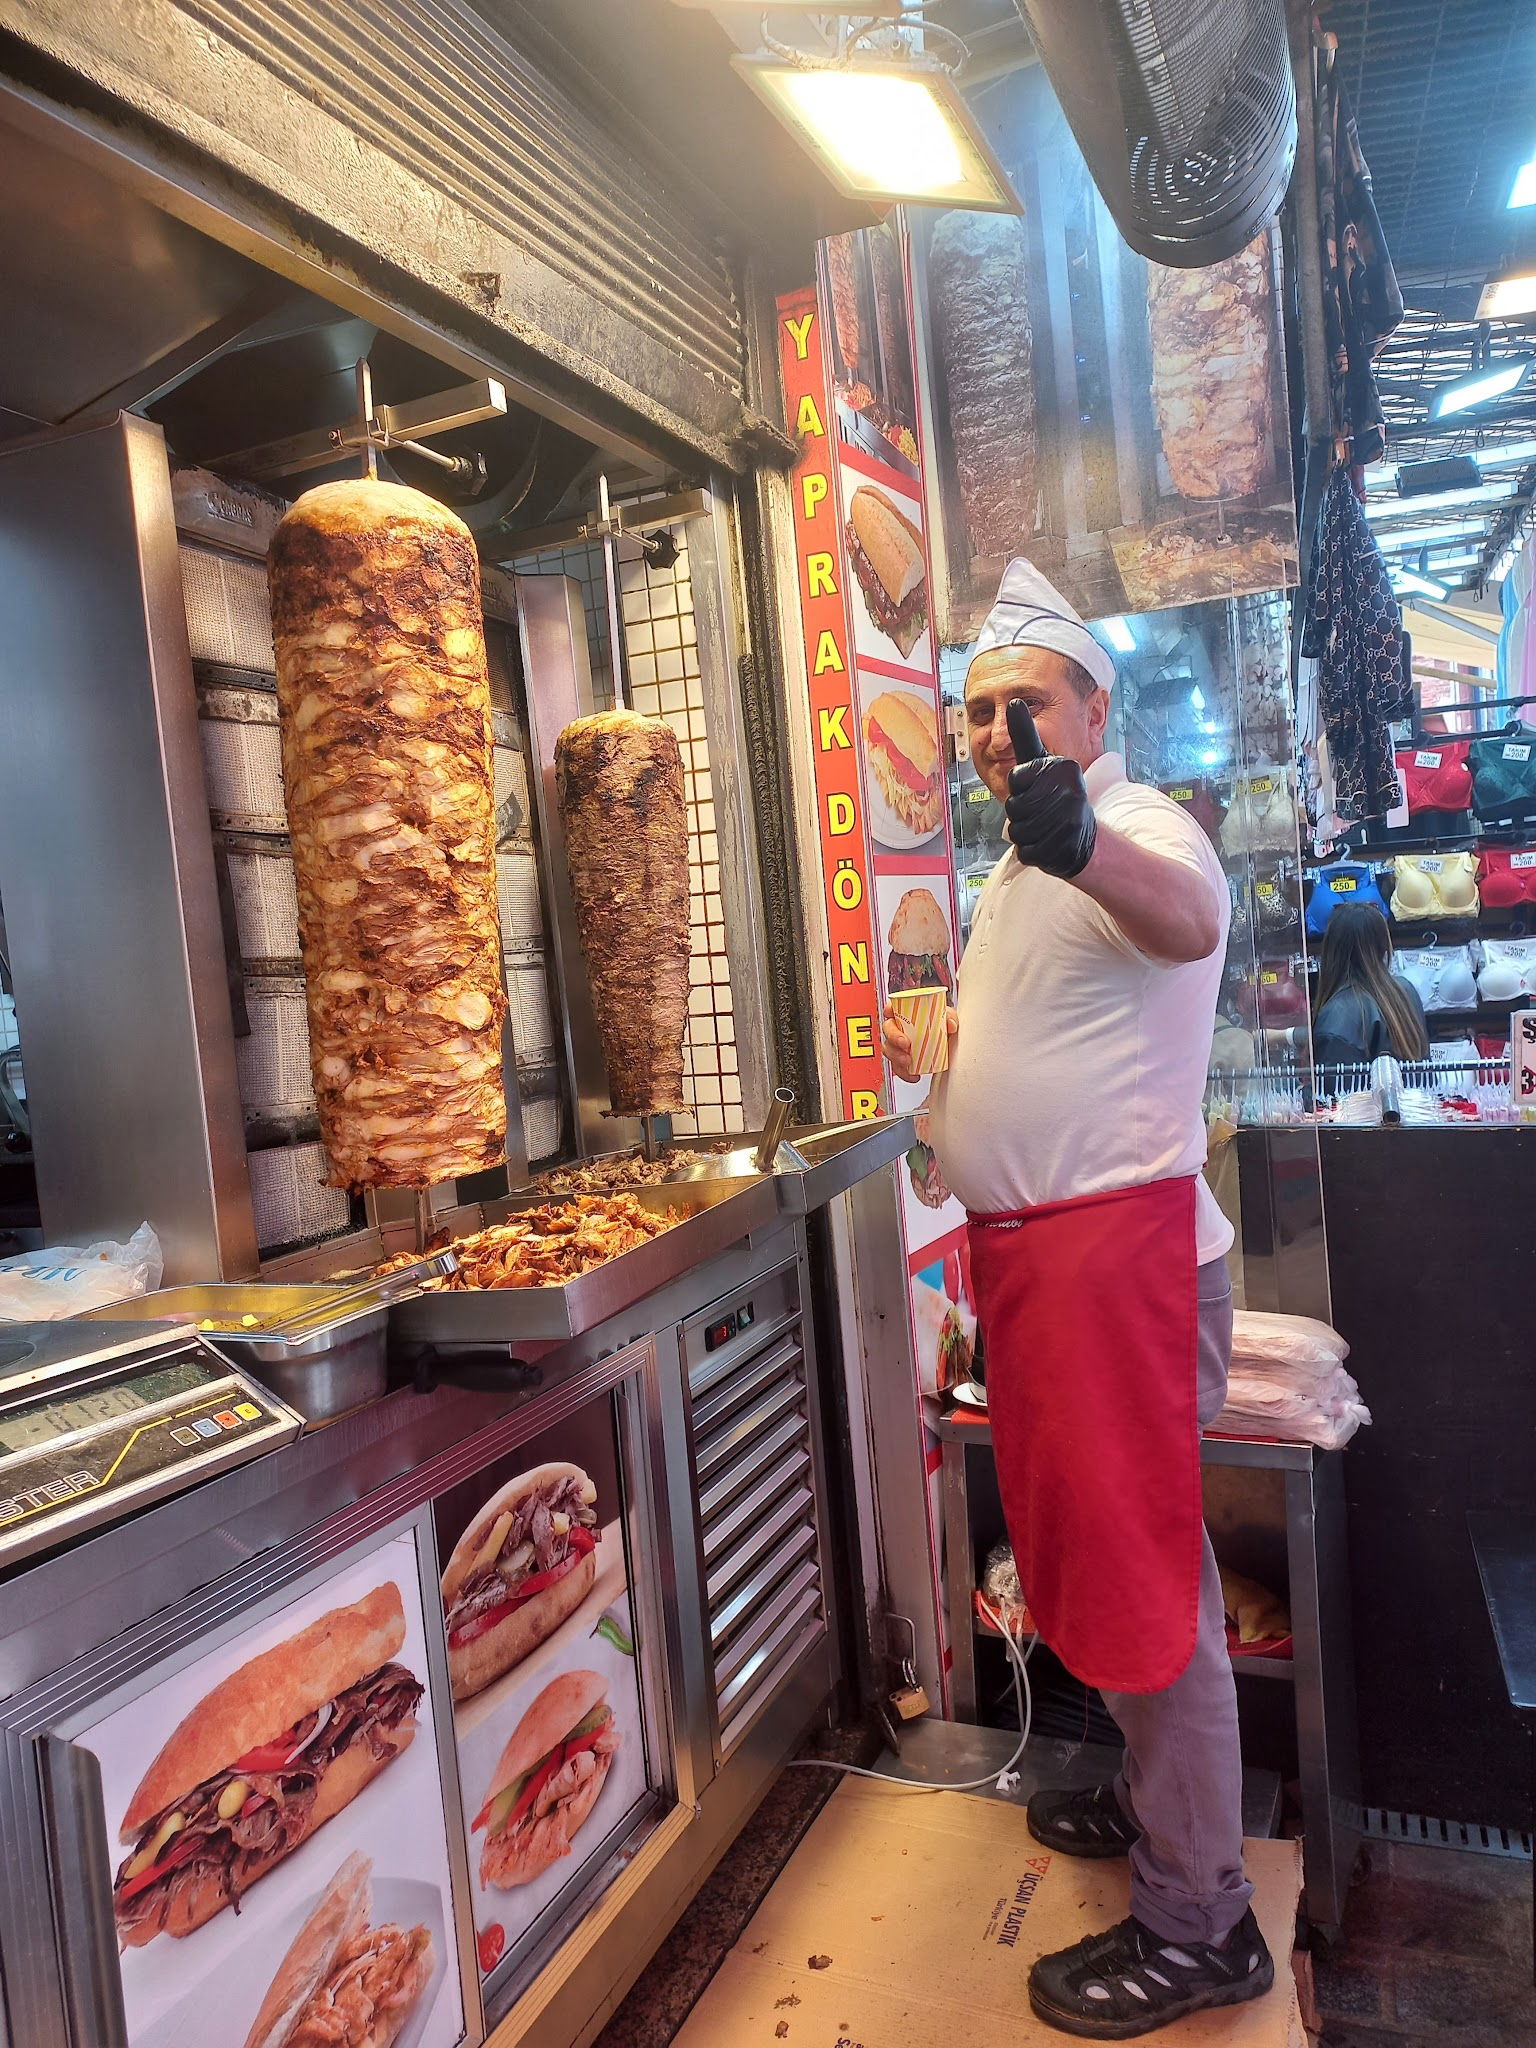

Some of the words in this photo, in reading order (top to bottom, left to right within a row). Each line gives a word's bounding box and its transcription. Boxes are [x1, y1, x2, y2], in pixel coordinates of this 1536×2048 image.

[784, 313, 853, 752] YAPRAK
[826, 790, 879, 1121] DÖNER
[971, 792, 985, 800] 250
[1172, 791, 1187, 800] 250
[1333, 882, 1350, 891] 250
[1014, 1872, 1044, 1905] ÜÇSAN
[996, 1906, 1028, 1948] PLASTİK
